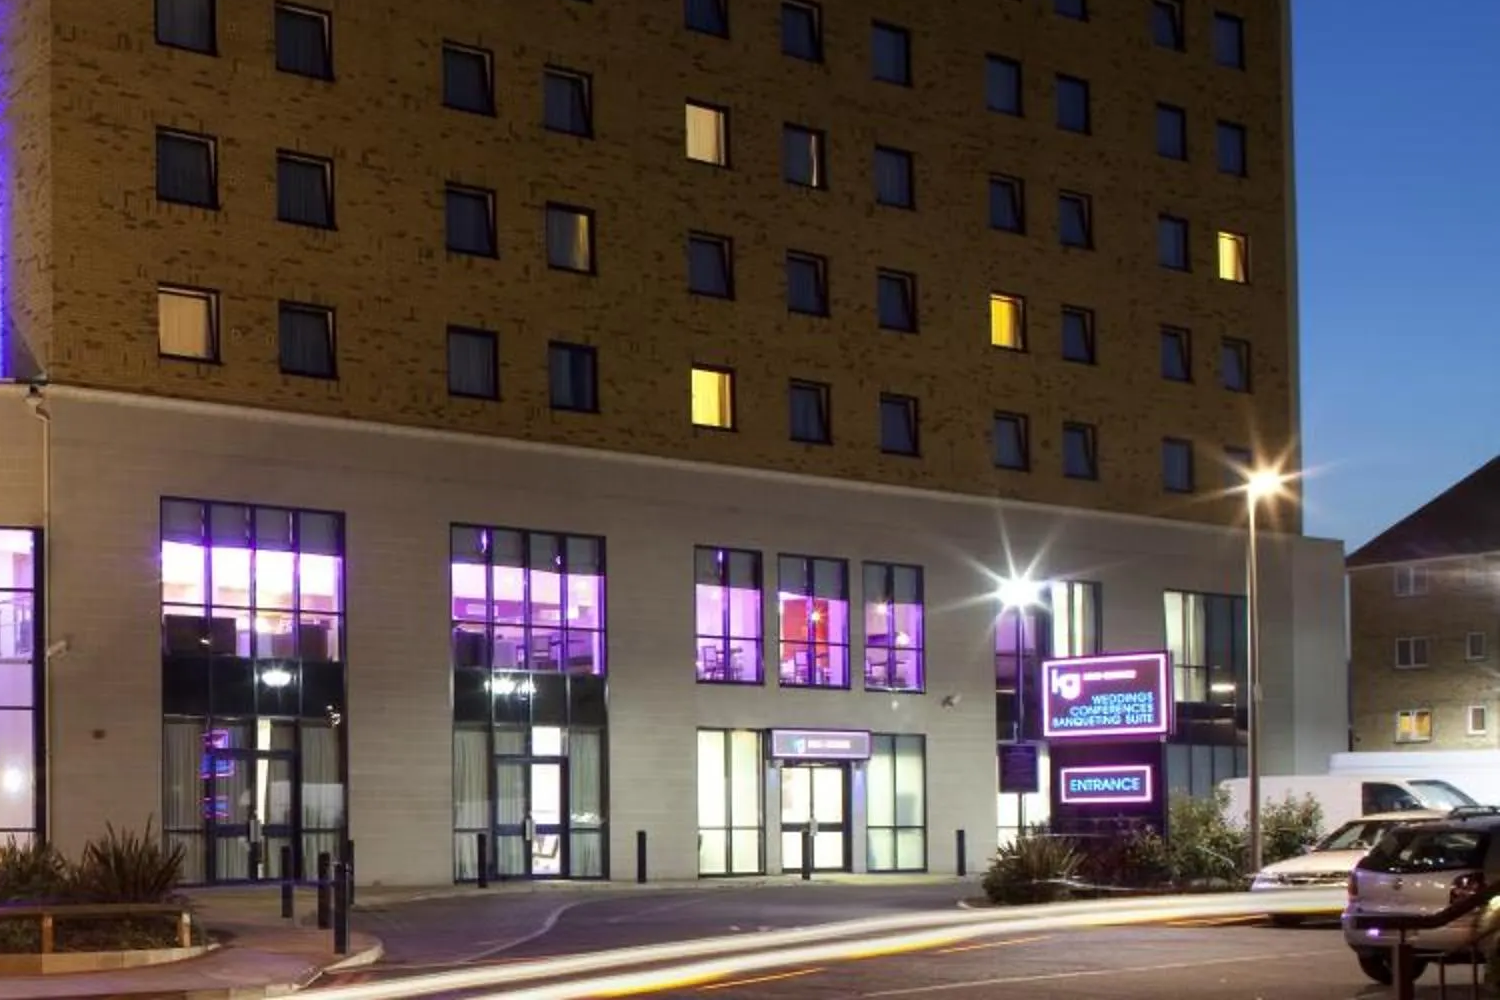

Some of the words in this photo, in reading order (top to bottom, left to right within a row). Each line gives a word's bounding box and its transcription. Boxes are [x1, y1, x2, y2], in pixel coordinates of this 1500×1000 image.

[1091, 691, 1153, 704] WEDDINGS
[1069, 703, 1153, 717] CONFERENCES
[1052, 714, 1121, 728] BANQUETING
[1125, 713, 1153, 724] SUITE
[1069, 777, 1141, 792] ENTRANCE
